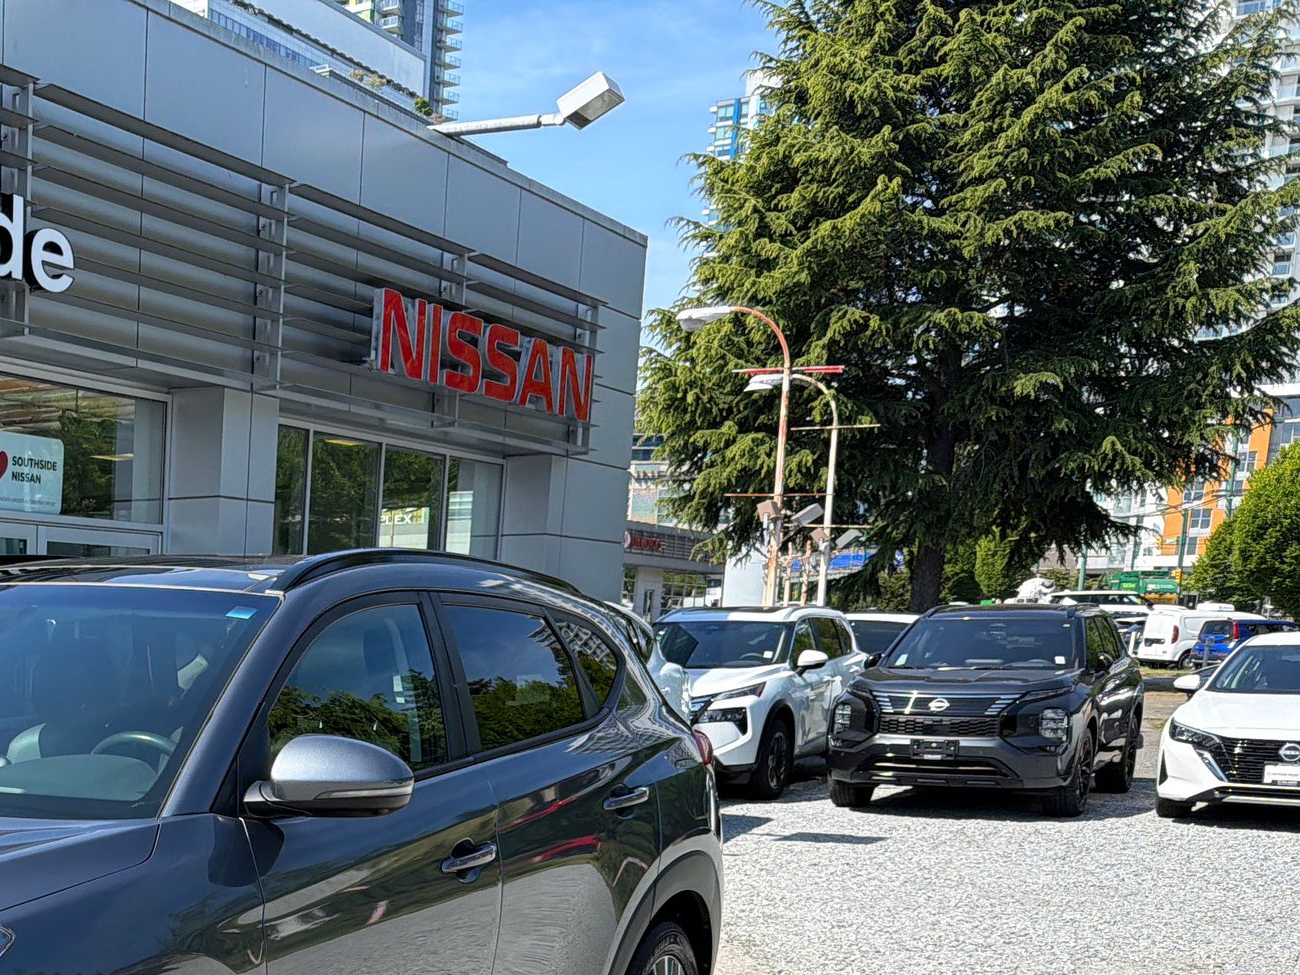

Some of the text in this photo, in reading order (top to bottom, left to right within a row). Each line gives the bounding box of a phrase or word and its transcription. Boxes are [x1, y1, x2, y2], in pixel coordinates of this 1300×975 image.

[378, 287, 594, 422] NISSAN
[11, 455, 58, 471] SOUTHSIDE
[11, 471, 42, 484] NISSAN
